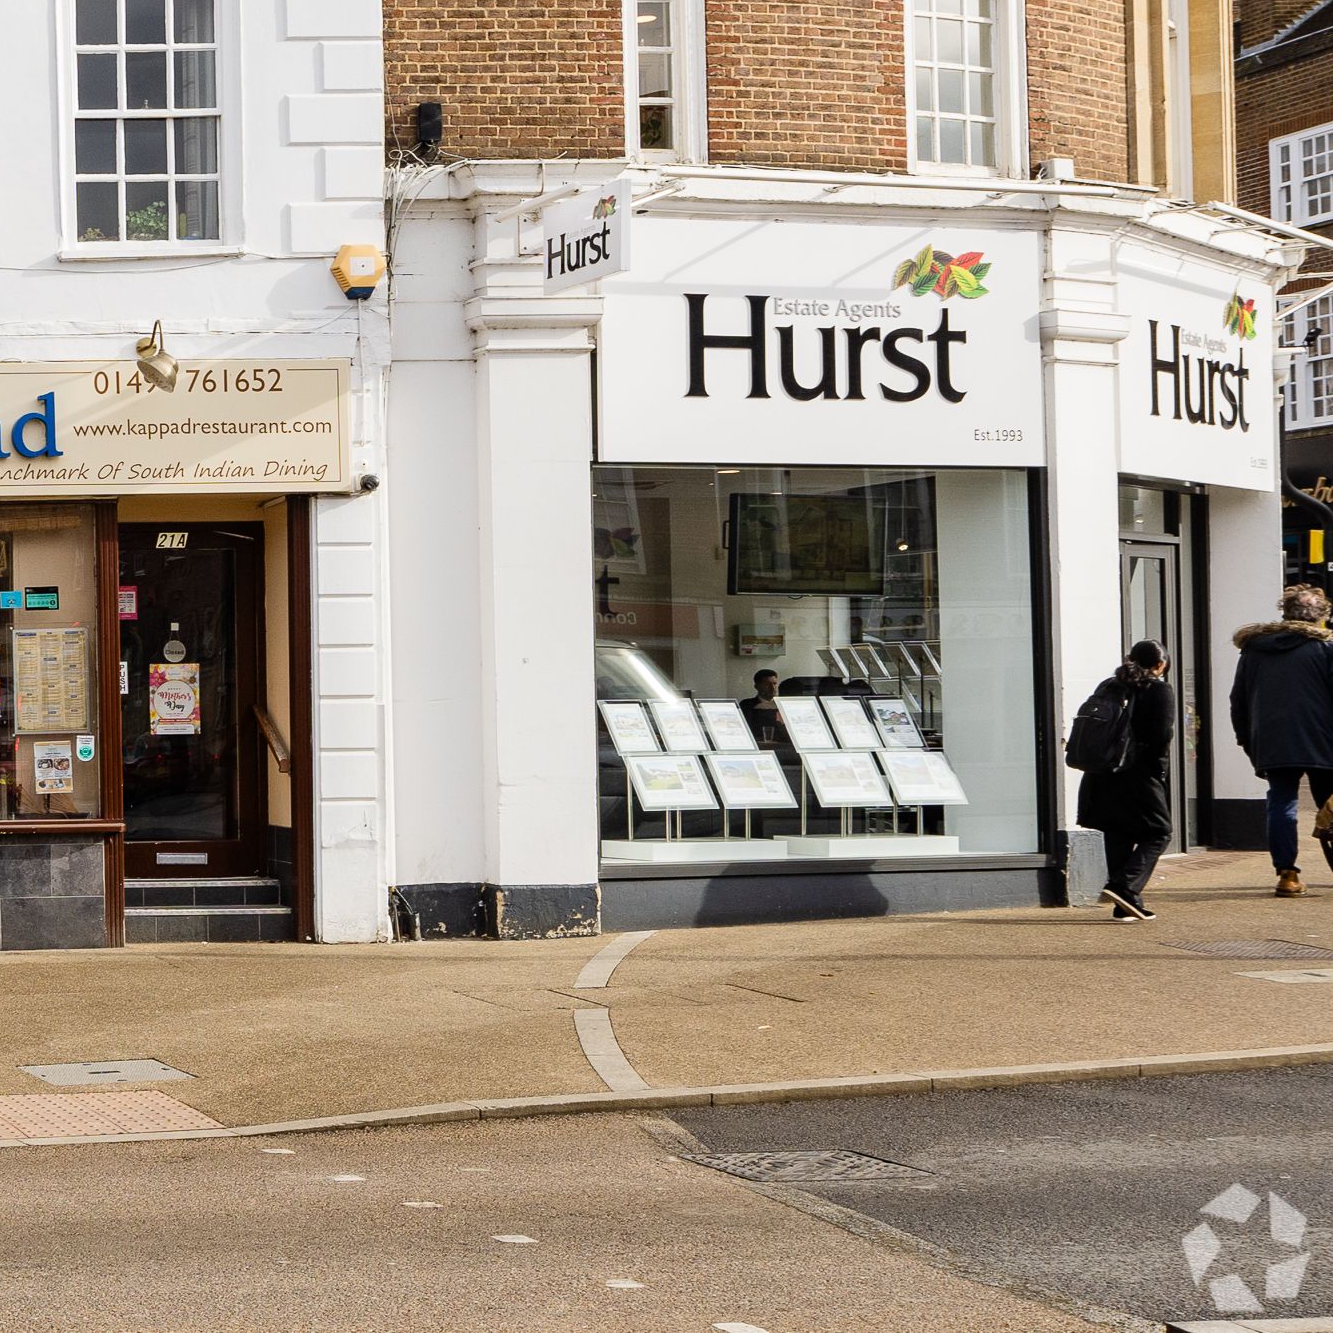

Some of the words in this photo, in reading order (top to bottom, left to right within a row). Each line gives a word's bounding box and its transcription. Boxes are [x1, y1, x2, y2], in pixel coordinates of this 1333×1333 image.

[547, 221, 610, 279] Hurst
[774, 297, 830, 317] Estate
[834, 298, 902, 323] Agents
[683, 293, 969, 404] Hurst
[94, 370, 163, 395] 014
[186, 368, 284, 394] 761652
[1148, 319, 1250, 433] Hurst
[73, 418, 333, 440] www.kappadrestaurant.com
[973, 429, 1023, 443] Est.1993
[97, 462, 125, 480] Of
[128, 462, 185, 480] South
[193, 460, 256, 479] Indian
[263, 459, 328, 482] Dining
[157, 533, 186, 548] 21A
